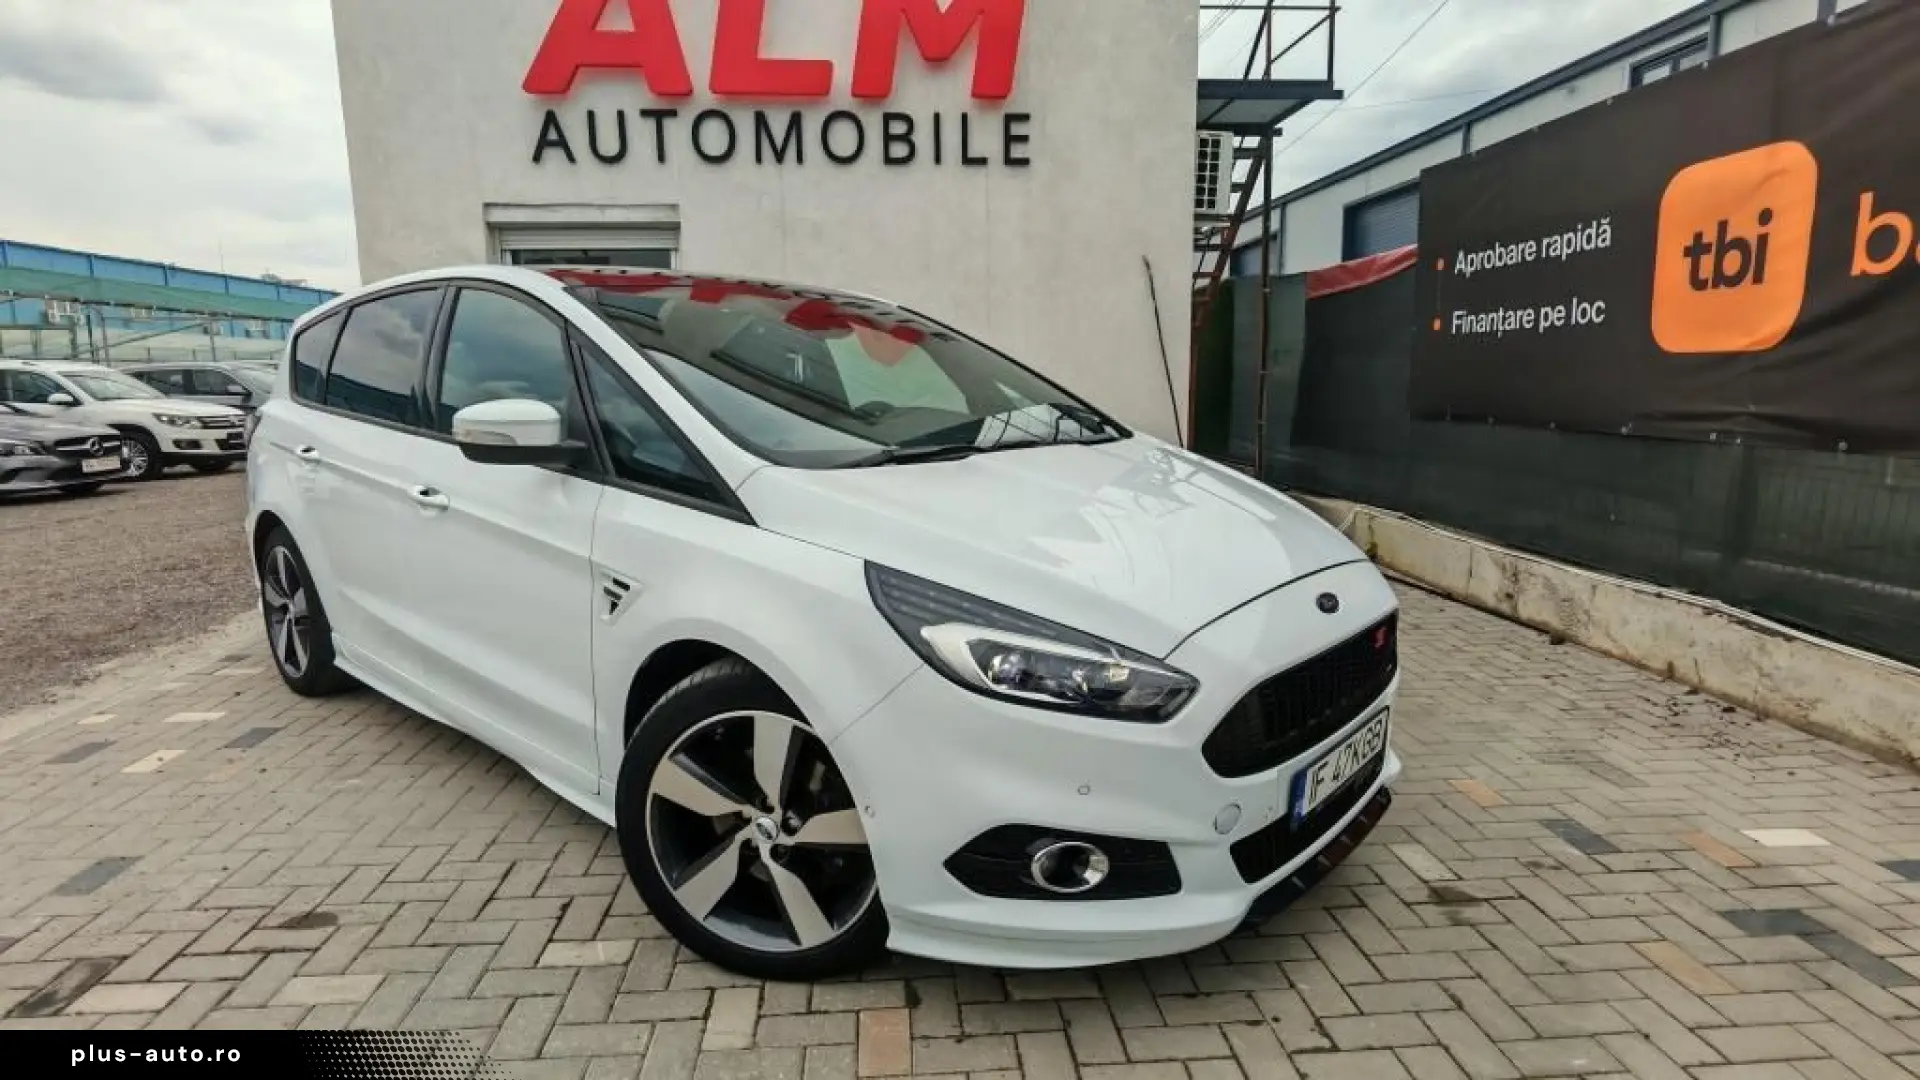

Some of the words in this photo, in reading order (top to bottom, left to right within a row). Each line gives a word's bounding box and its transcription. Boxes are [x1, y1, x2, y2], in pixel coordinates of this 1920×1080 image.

[522, 0, 1025, 99] ALM
[532, 108, 1031, 166] AUTOMOBILE
[1454, 241, 1537, 278] Aprobare
[1541, 216, 1611, 262] rapidă
[1683, 207, 1773, 292] tbi
[1850, 190, 1920, 276] b
[1452, 306, 1535, 338] Finanțare
[1539, 304, 1566, 334] pe
[1571, 296, 1606, 326] loc
